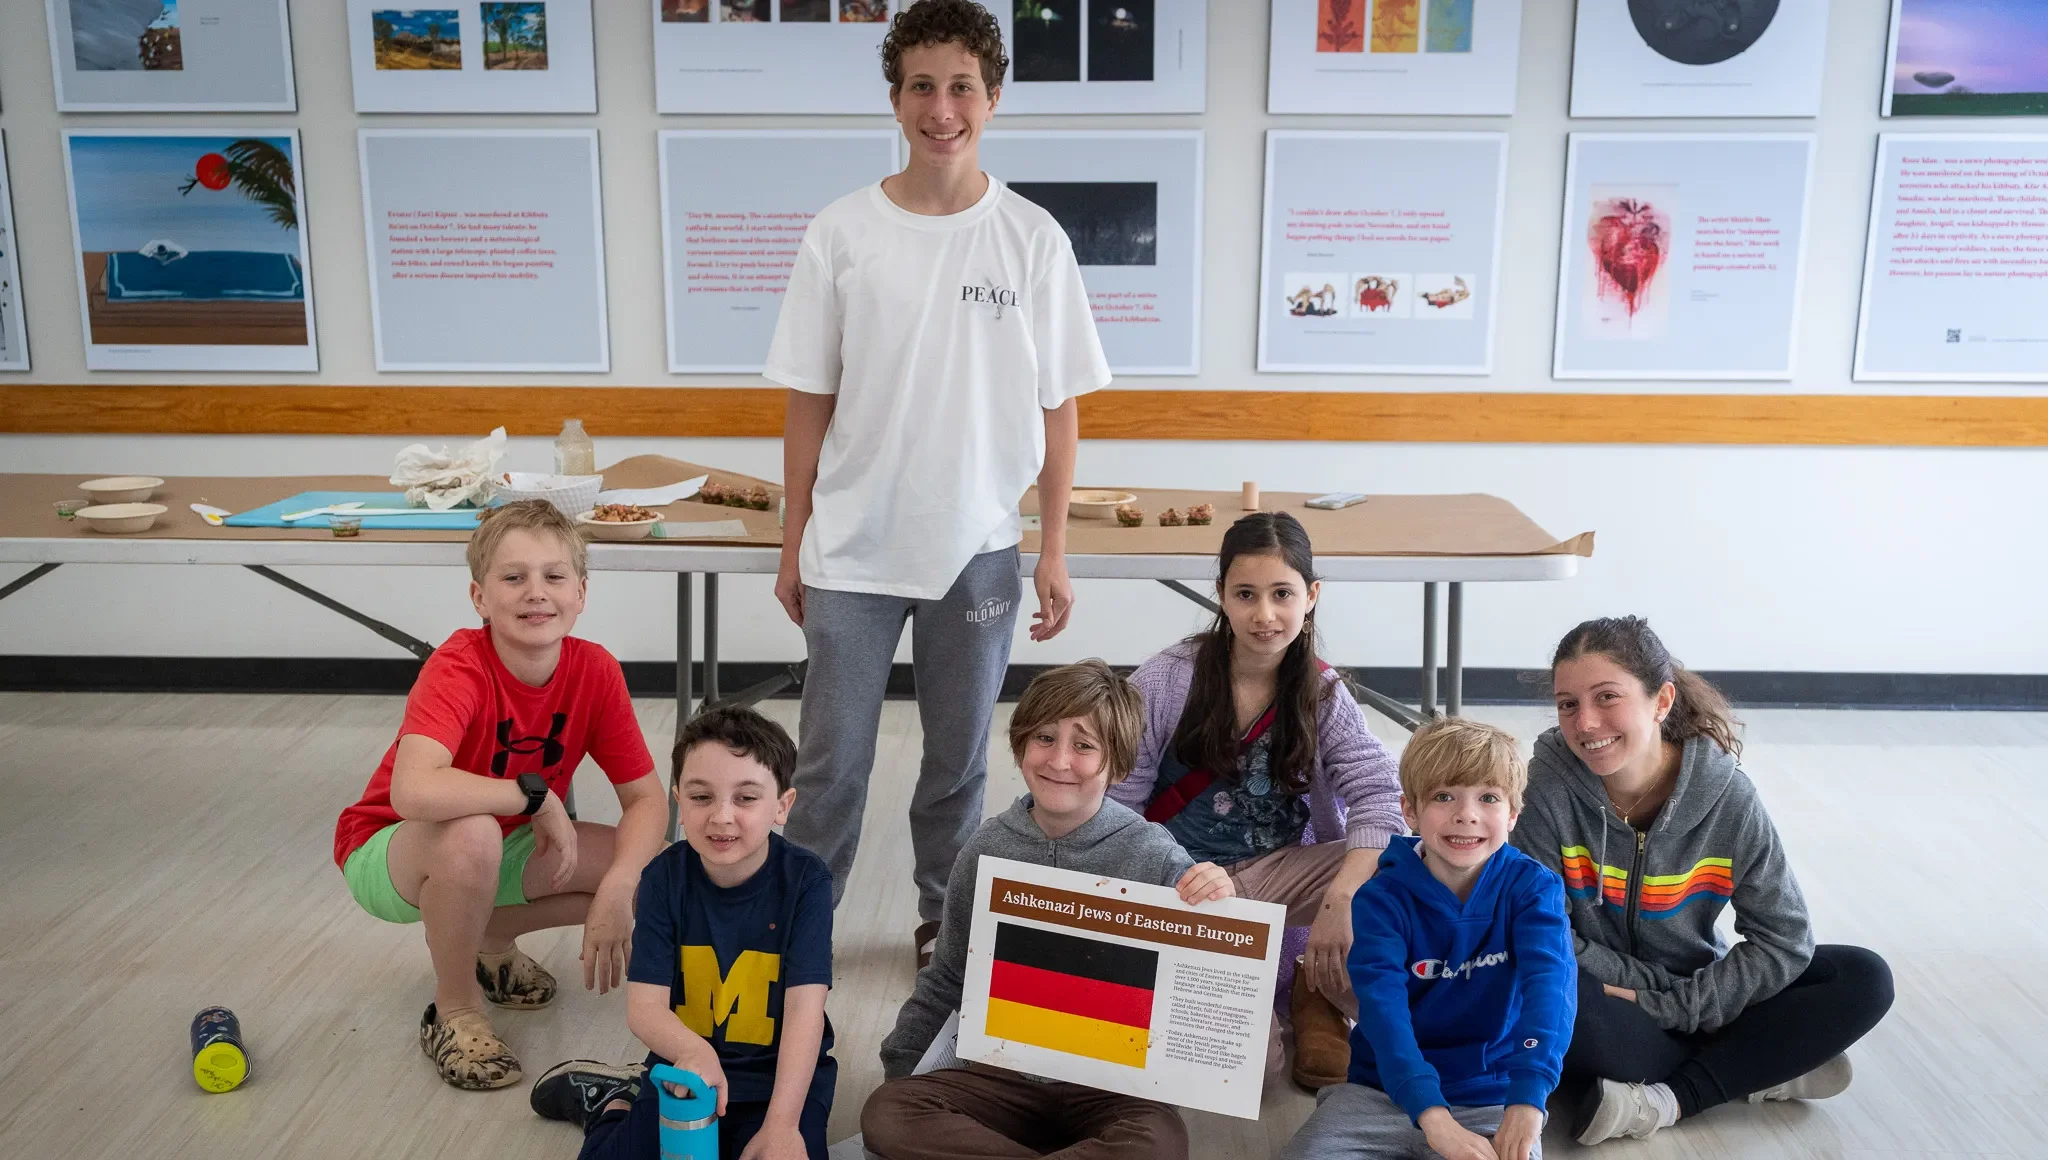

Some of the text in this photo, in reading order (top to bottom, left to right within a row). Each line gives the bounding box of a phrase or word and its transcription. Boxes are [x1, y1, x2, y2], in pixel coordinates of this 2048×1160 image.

[966, 608, 987, 623] OLD
[989, 600, 1011, 619] NAVY
[1002, 891, 1253, 947] Ashkenazi Jews of Eastern Europe
[1176, 963, 1201, 971] Ashkenazi
[1224, 976, 1241, 984] Europe
[1174, 980, 1195, 988] language
[1212, 986, 1229, 994] Yiddish
[1215, 982, 1237, 990] speaking
[675, 945, 780, 1047] M
[1203, 991, 1223, 999] German
[1197, 1001, 1222, 1009] wonderful
[1223, 1006, 1254, 1015] communities
[1170, 1014, 1189, 1022] creating
[1223, 1017, 1249, 1025] storytellers
[1169, 1019, 1194, 1028] inventions
[1205, 1026, 1226, 1034] changed
[1184, 1033, 1208, 1041] Ashkenazi
